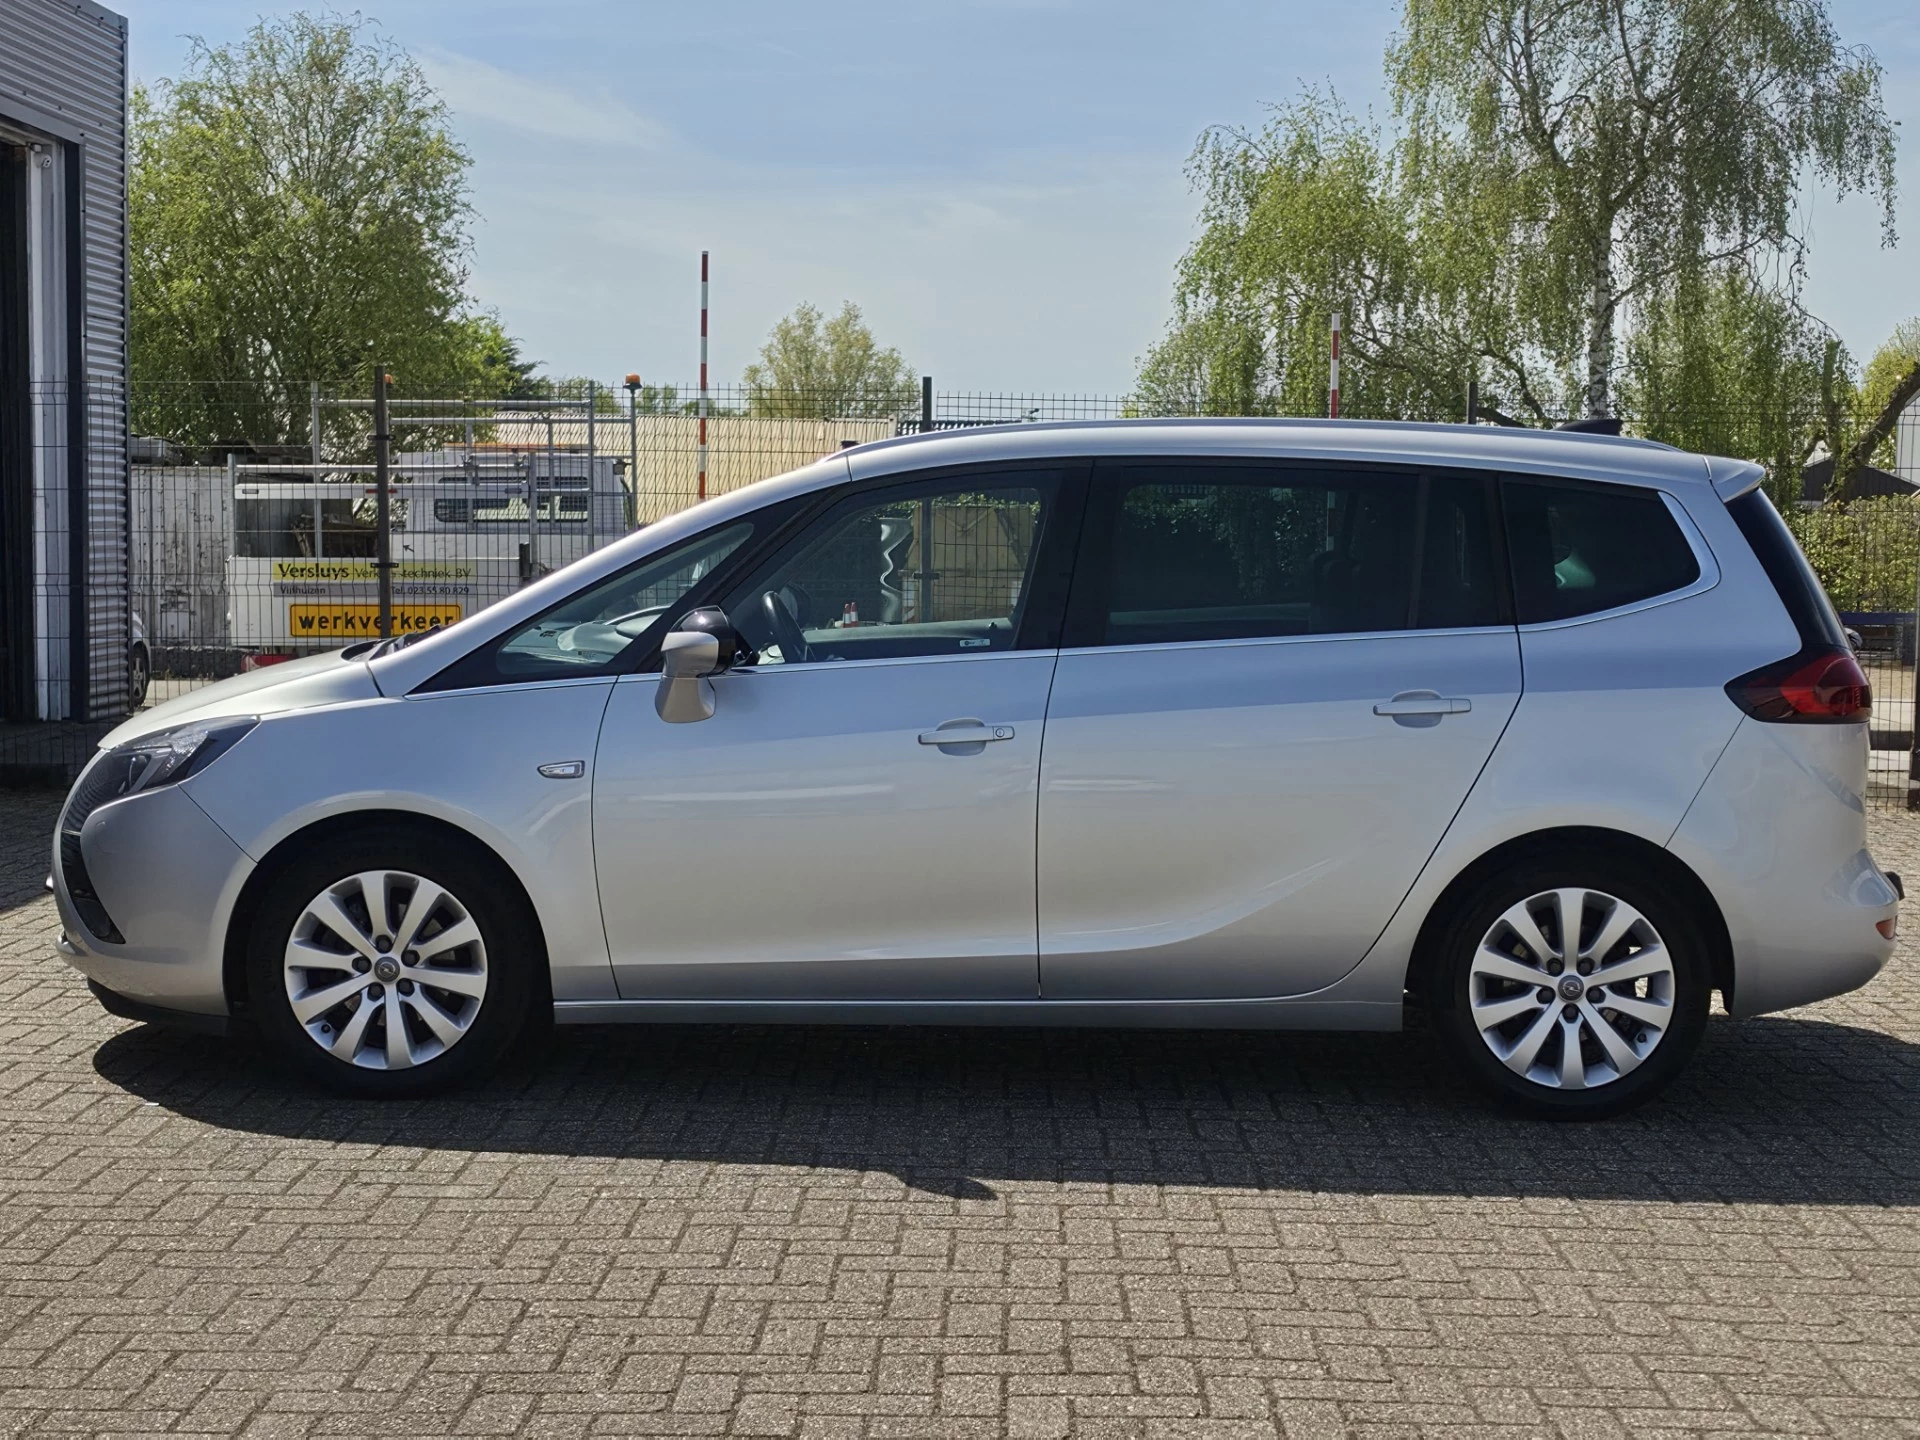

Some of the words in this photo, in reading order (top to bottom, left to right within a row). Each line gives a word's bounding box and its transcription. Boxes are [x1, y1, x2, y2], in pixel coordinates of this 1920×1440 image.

[278, 563, 349, 580] Versluys
[456, 567, 472, 579] BV
[280, 585, 326, 595] Vijfhuizen
